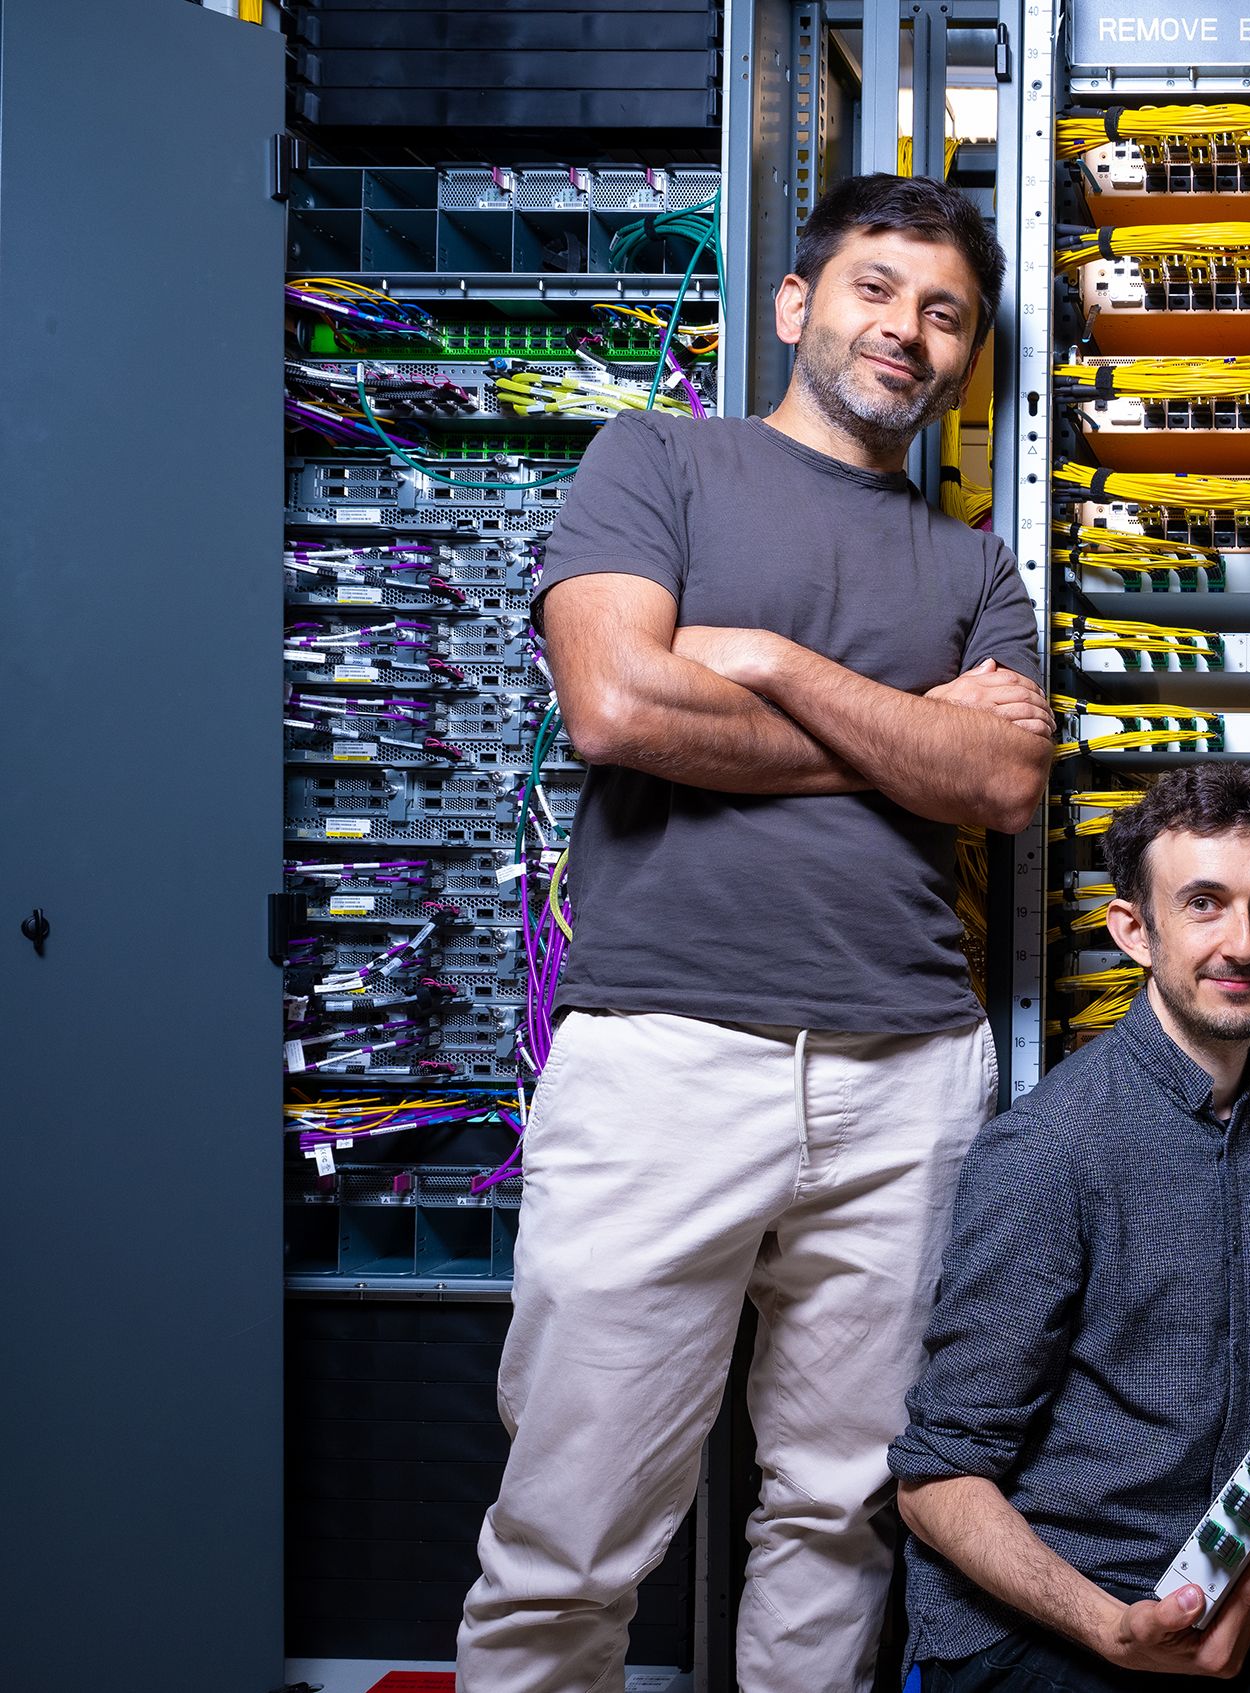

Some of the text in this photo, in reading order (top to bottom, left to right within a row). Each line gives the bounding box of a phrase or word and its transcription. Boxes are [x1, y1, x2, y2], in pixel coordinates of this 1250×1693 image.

[1028, 6, 1039, 16] 40
[1100, 18, 1218, 42] REMOVE
[1027, 48, 1039, 58] 39
[1023, 304, 1035, 314] 33
[1023, 347, 1034, 357] 32
[1021, 519, 1033, 529] 28
[1017, 864, 1028, 874] 20
[1017, 907, 1028, 917] 19
[1016, 950, 1027, 960] 18
[1015, 1037, 1026, 1048] 16
[1014, 1081, 1025, 1091] 15
